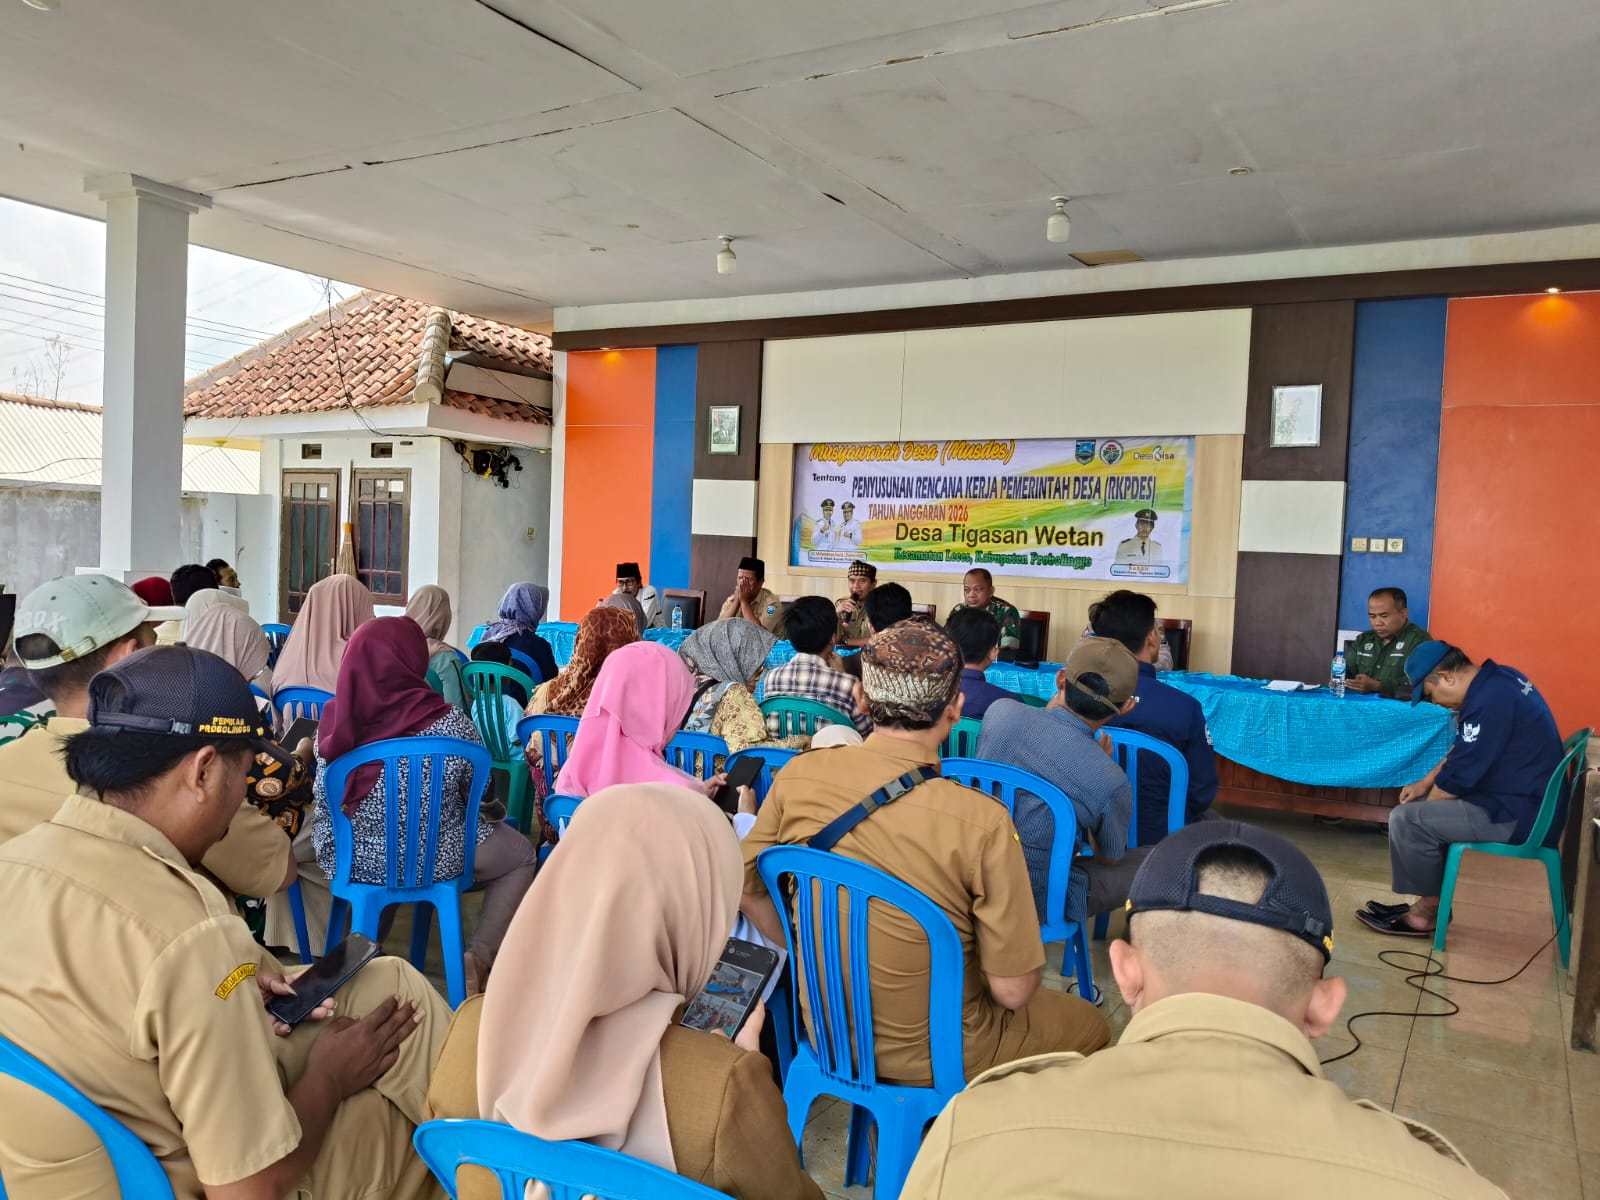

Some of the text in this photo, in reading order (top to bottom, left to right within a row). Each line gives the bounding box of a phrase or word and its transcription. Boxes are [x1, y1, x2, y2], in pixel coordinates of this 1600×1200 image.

[810, 439, 1016, 466] Musyawarah Desa (Musdes)
[812, 473, 846, 484] Tentang
[852, 476, 914, 498] PENYUSUNAN
[915, 476, 963, 499] RENCANA
[965, 476, 997, 499] KERJA
[1000, 476, 1071, 500] PEMERINTAH
[1072, 476, 1102, 500] DESA
[868, 503, 969, 522] TAHUN ANGGARAN 2026
[895, 522, 1104, 547] Desa Tigasan Wetan
[894, 547, 1092, 570] Kecamatan Leces, Kabupaten Probolinggo
[199, 724, 251, 734] PROBOLINGGO
